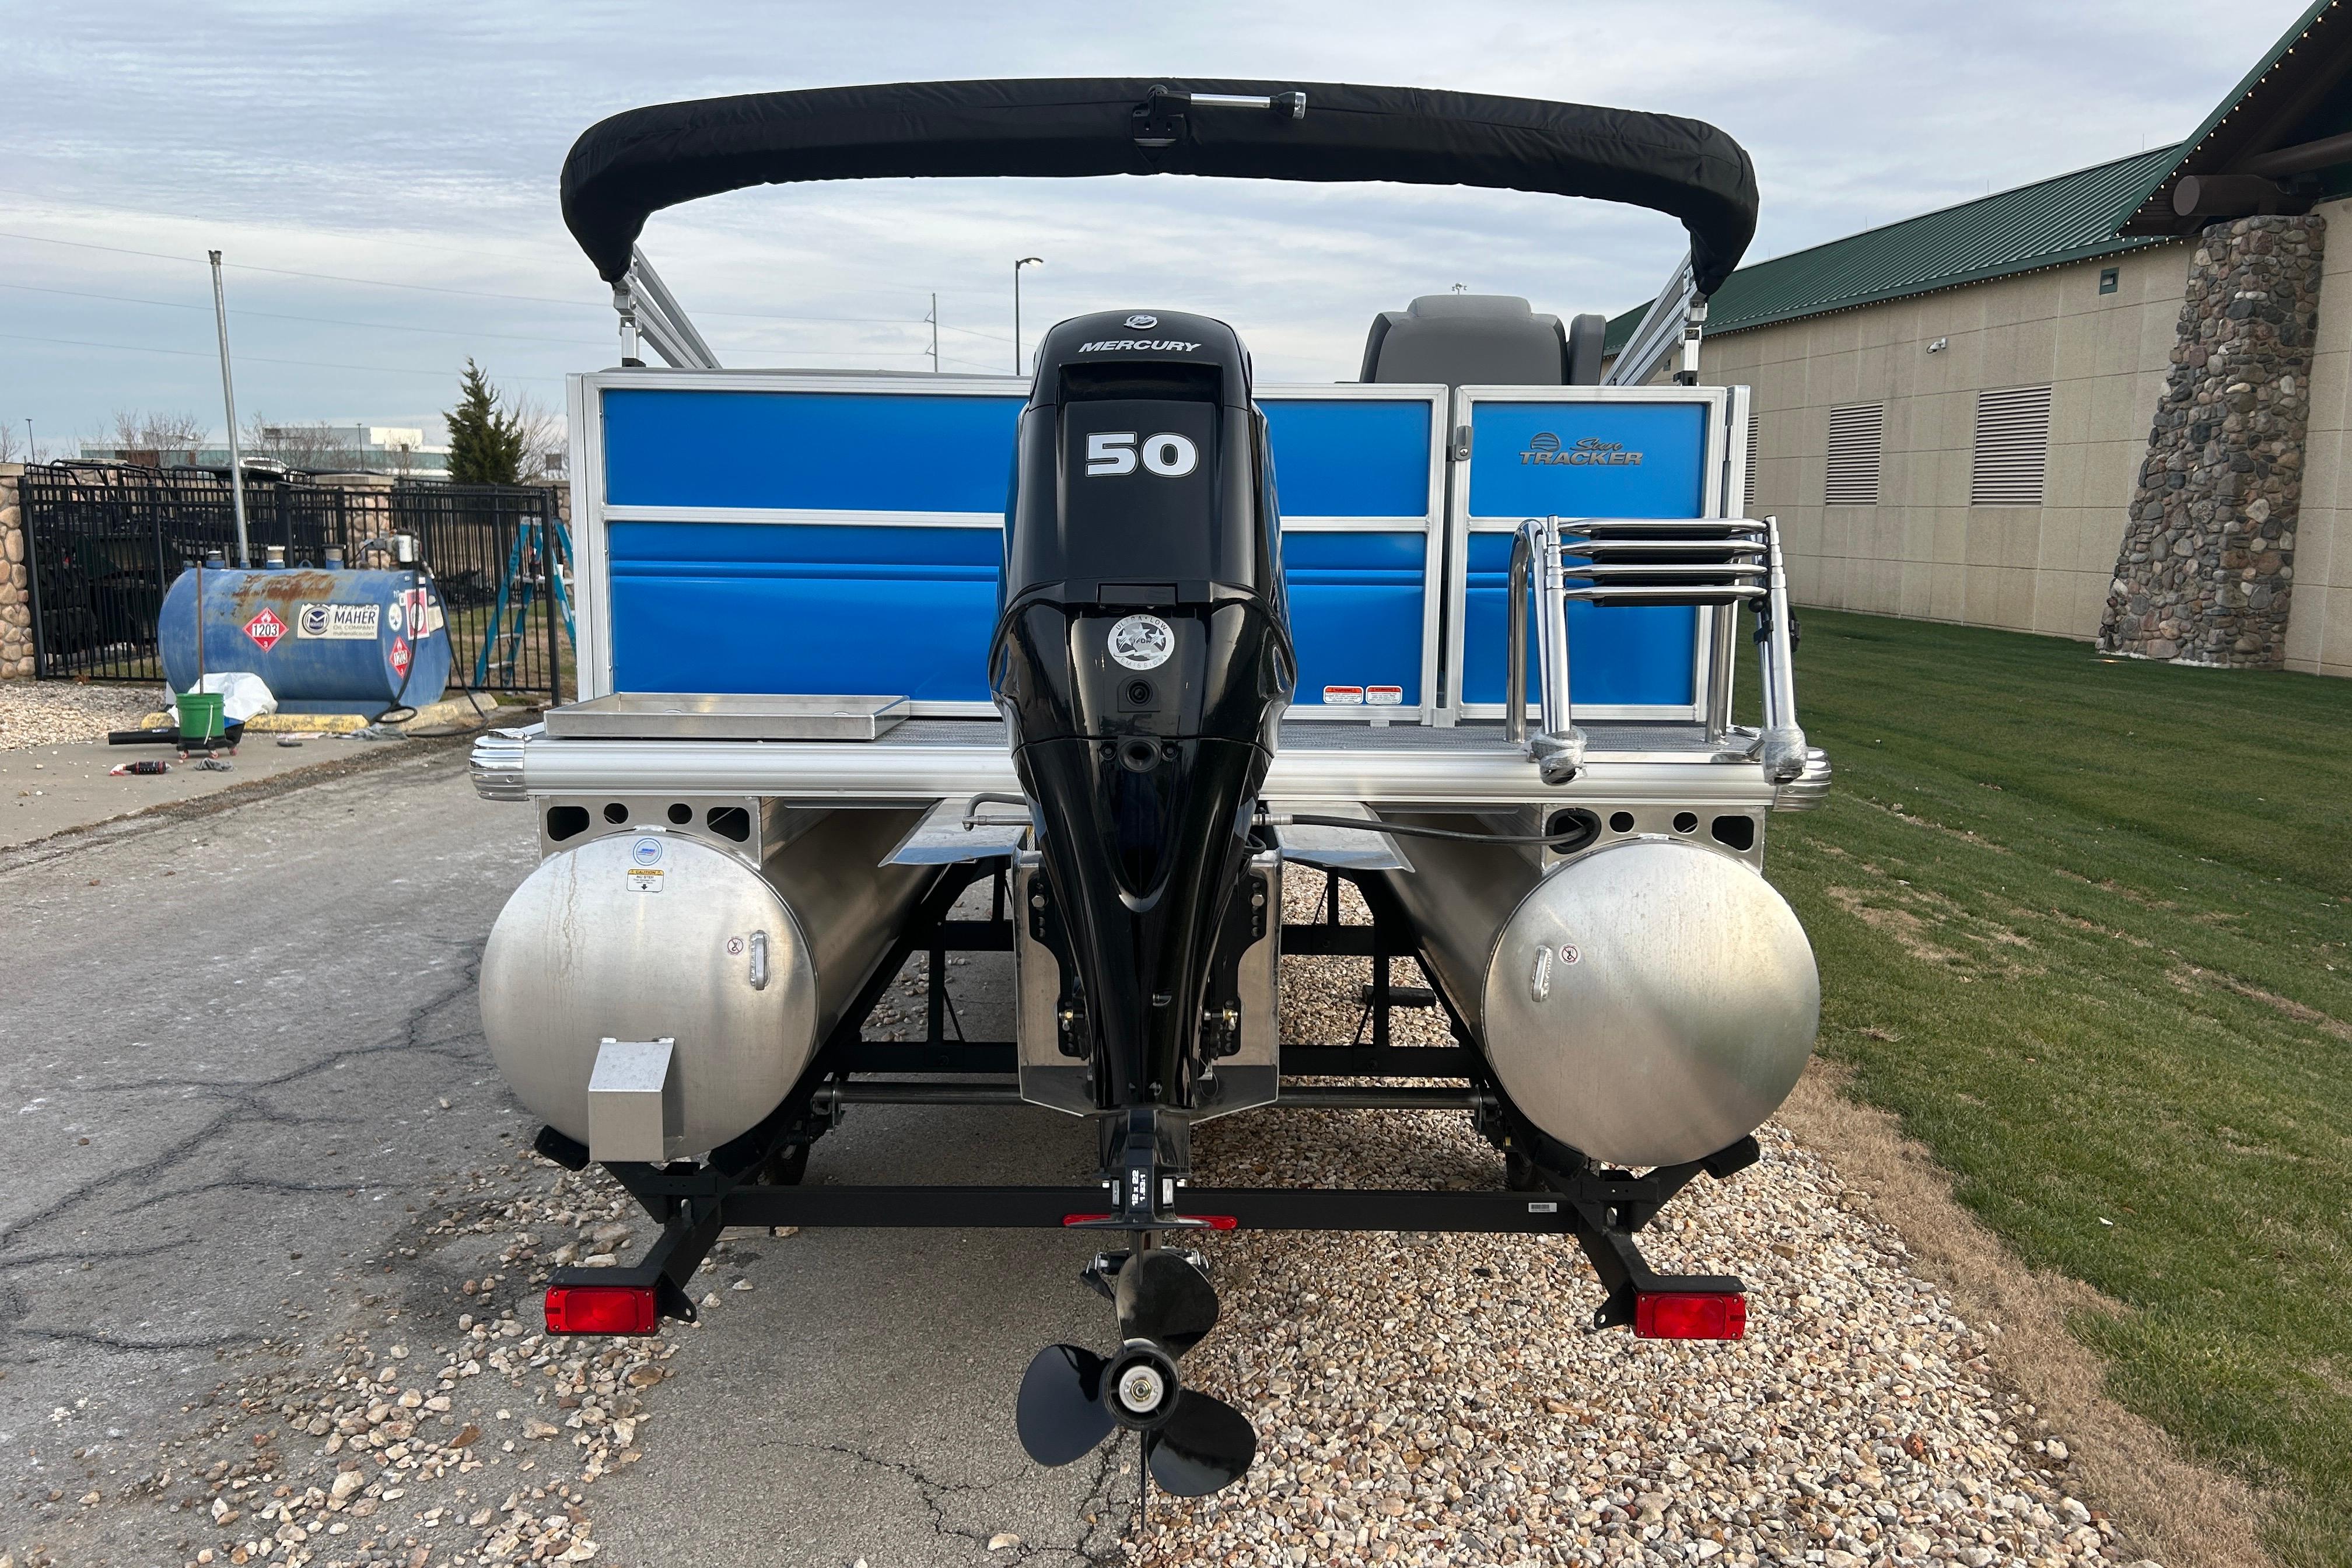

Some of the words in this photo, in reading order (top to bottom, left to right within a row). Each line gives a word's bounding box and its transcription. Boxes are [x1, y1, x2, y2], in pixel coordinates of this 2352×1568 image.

[1079, 340, 1202, 353] MERCURY
[1570, 438, 1623, 451] Sun
[1086, 432, 1198, 477] 50
[1519, 452, 1643, 465] TRACKER
[334, 611, 376, 624] MAHER
[1150, 617, 1167, 631] LOW
[254, 624, 278, 637] 1203
[394, 650, 407, 664] 1203
